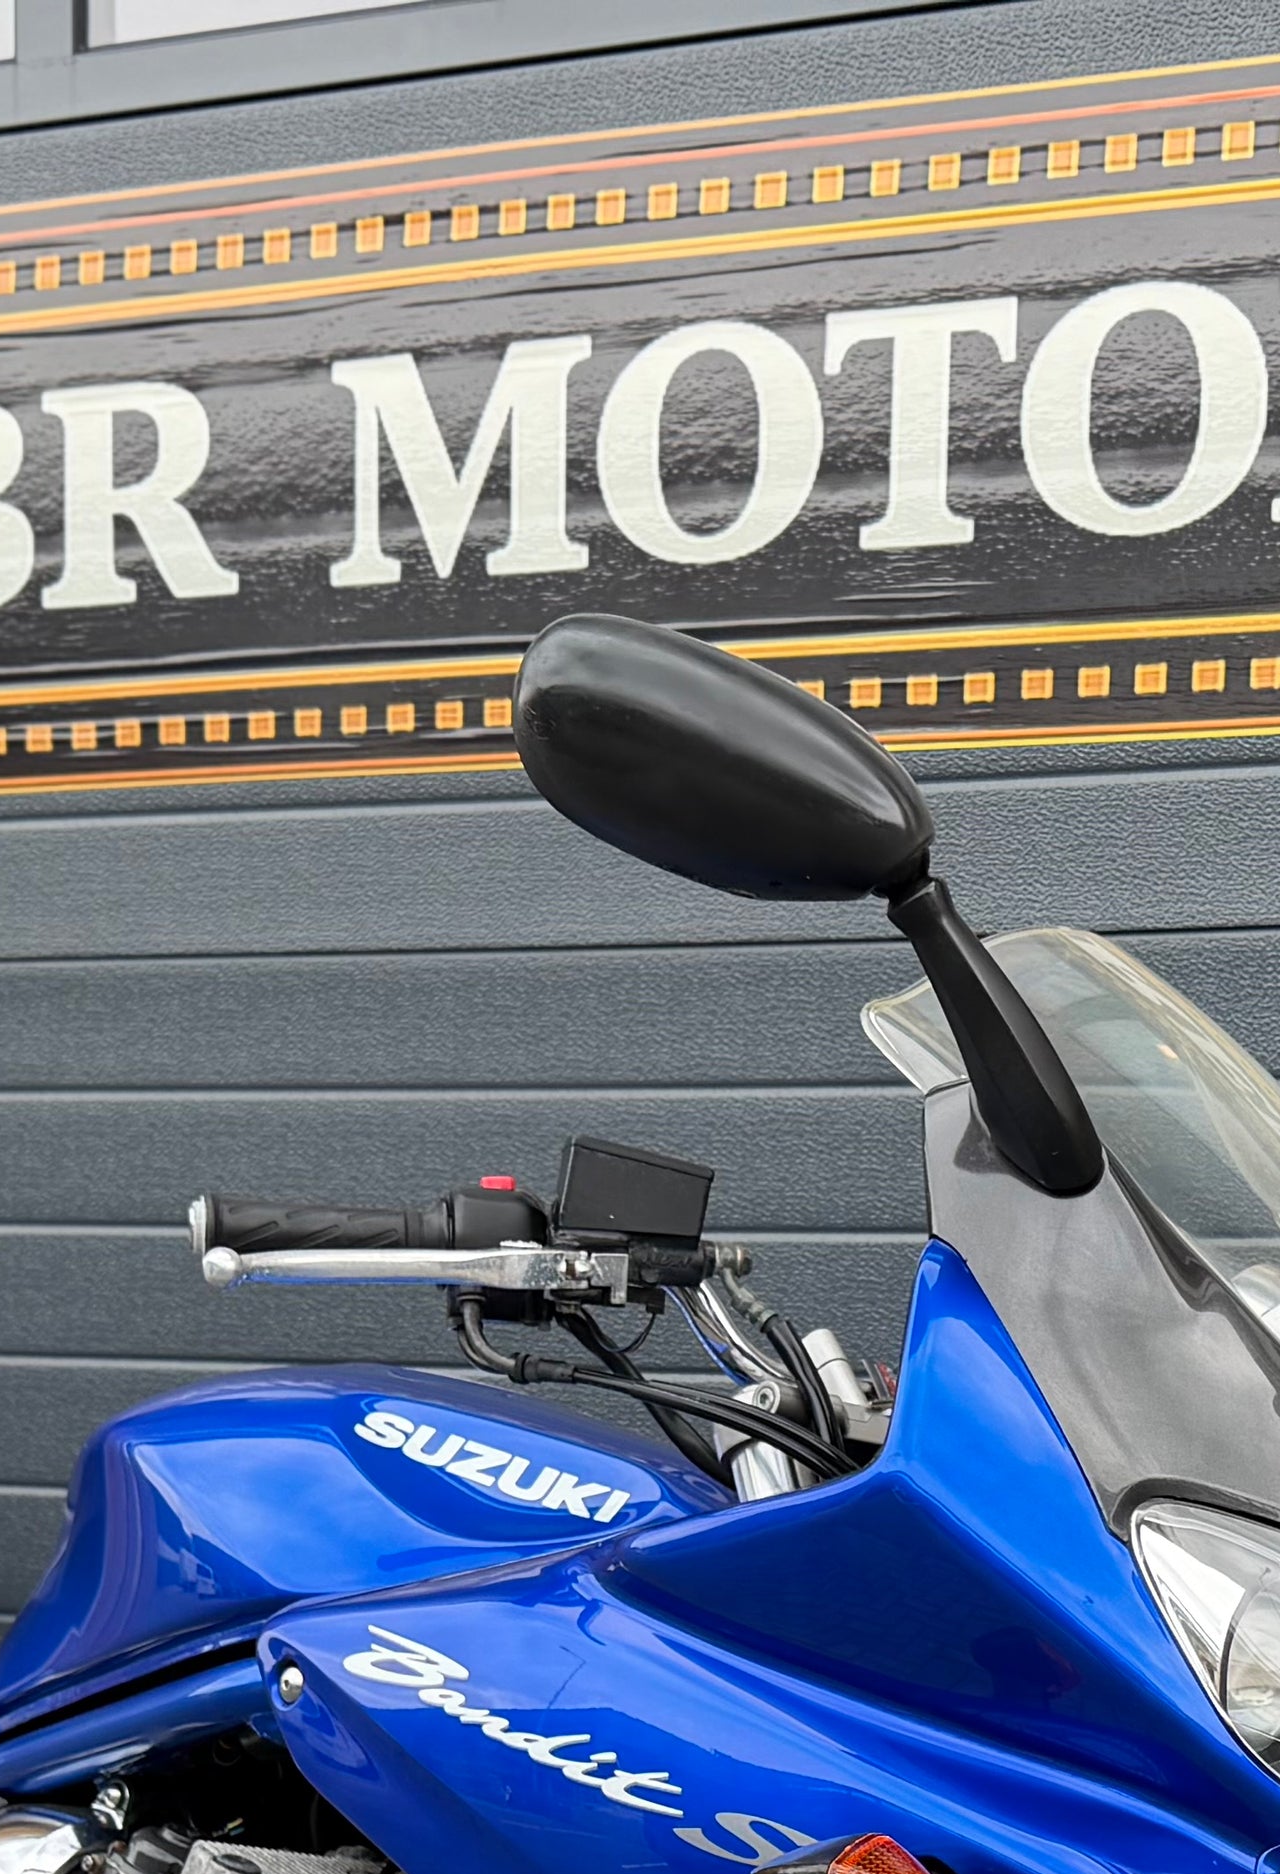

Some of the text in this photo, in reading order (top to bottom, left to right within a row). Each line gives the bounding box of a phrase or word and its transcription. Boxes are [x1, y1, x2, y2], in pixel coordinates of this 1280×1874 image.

[353, 1411, 631, 1523] SUZUKI
[342, 1624, 820, 1868] Bandit S
